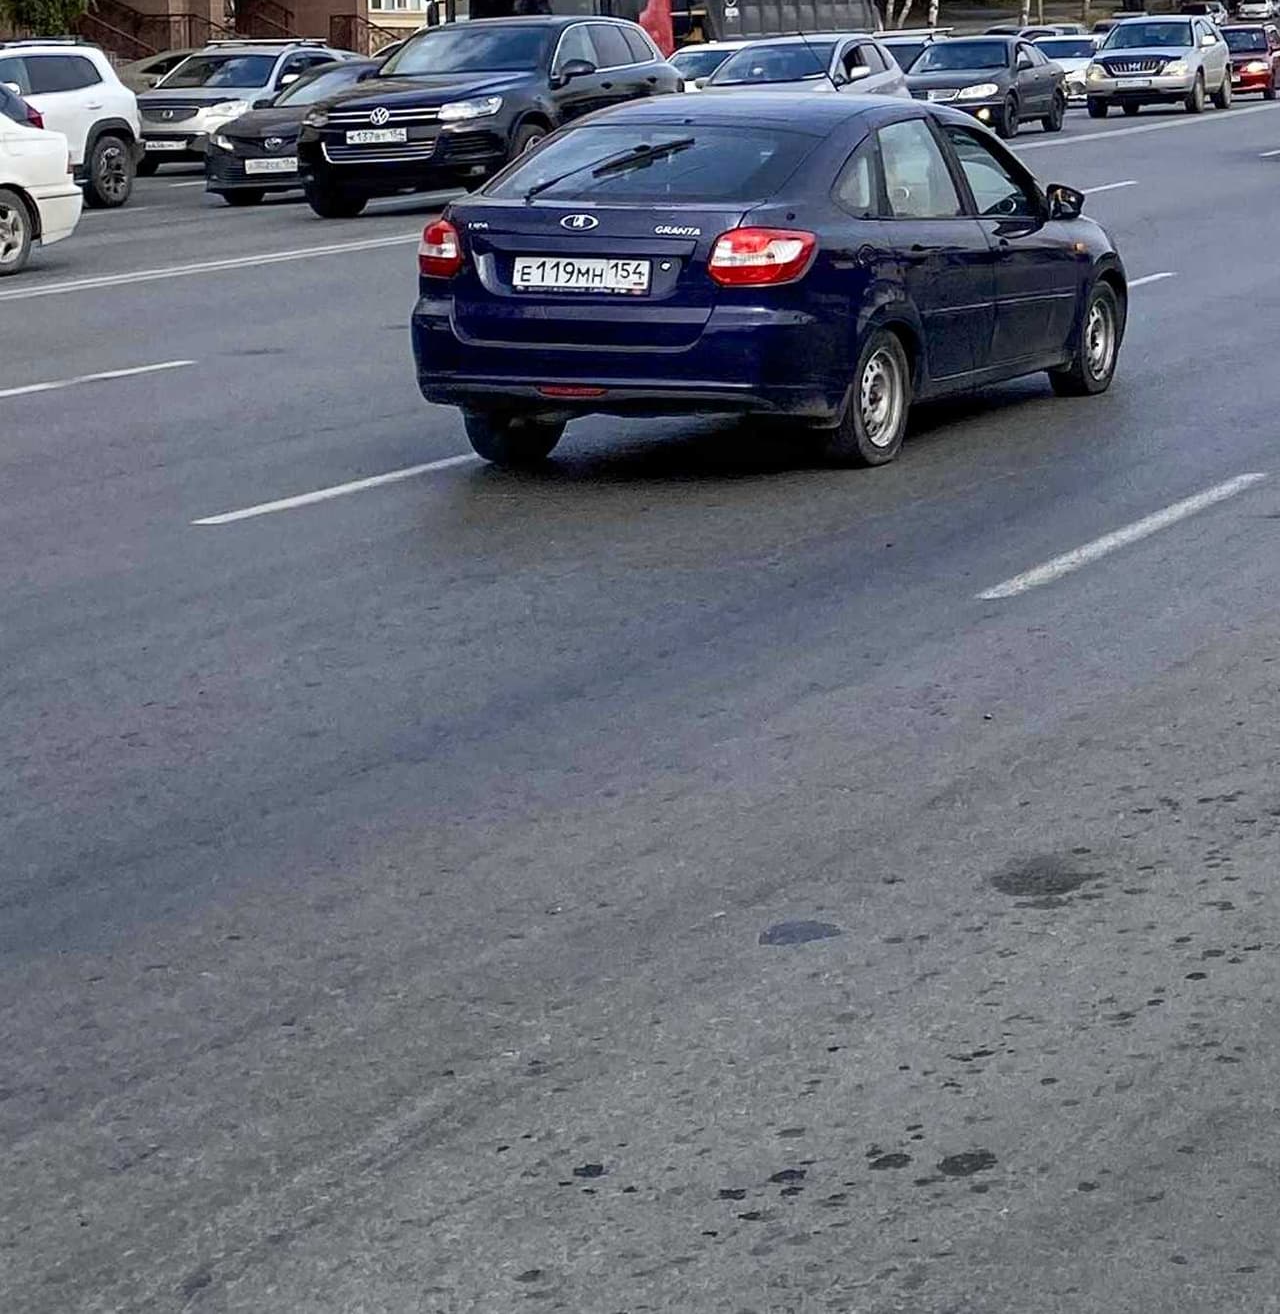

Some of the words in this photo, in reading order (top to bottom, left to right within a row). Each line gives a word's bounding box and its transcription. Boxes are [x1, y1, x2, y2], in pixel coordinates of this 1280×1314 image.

[654, 225, 701, 236] GRANTA
[519, 260, 605, 285] Е119МН
[609, 261, 646, 280] 154
